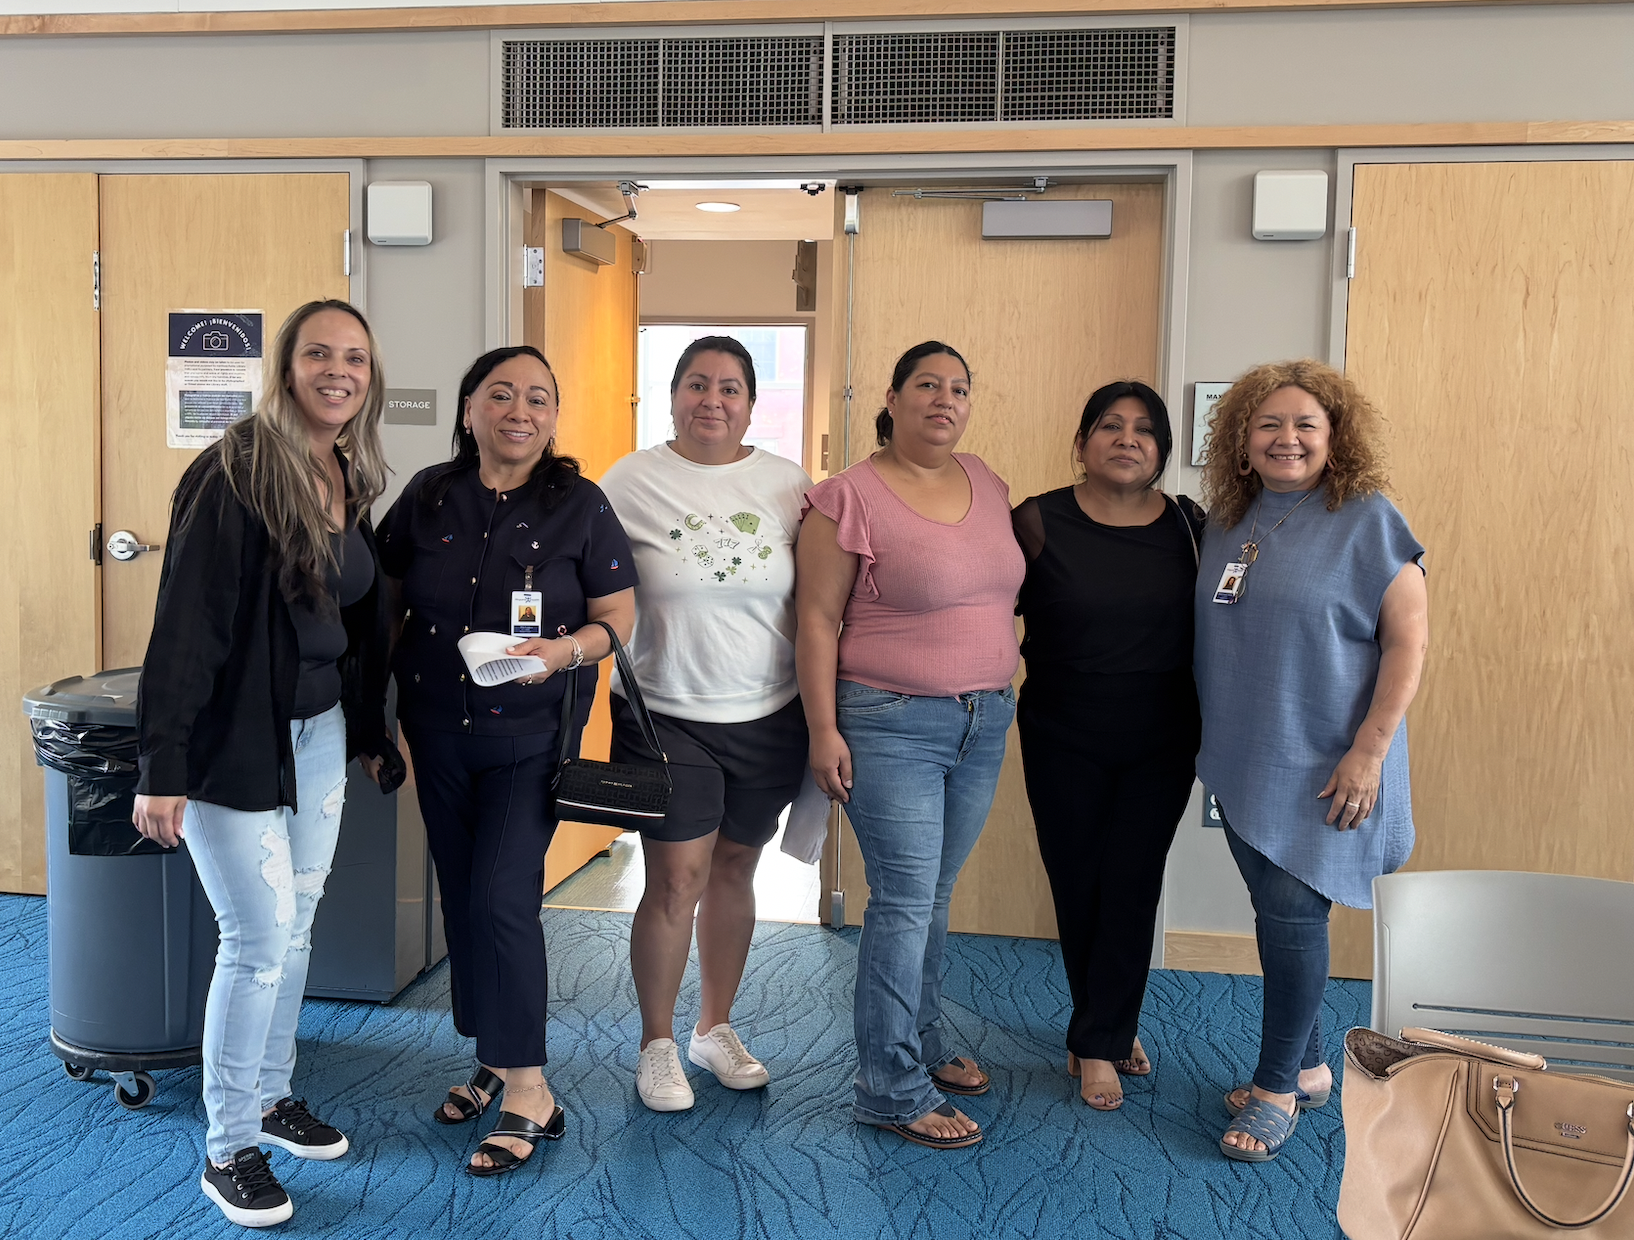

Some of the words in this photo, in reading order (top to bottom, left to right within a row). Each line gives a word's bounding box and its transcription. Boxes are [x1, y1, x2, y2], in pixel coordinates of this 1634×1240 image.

[180, 320, 208, 350] WELCOME!
[209, 318, 252, 351] ¡BIENVENIDOS!
[388, 400, 431, 409] STORAGE
